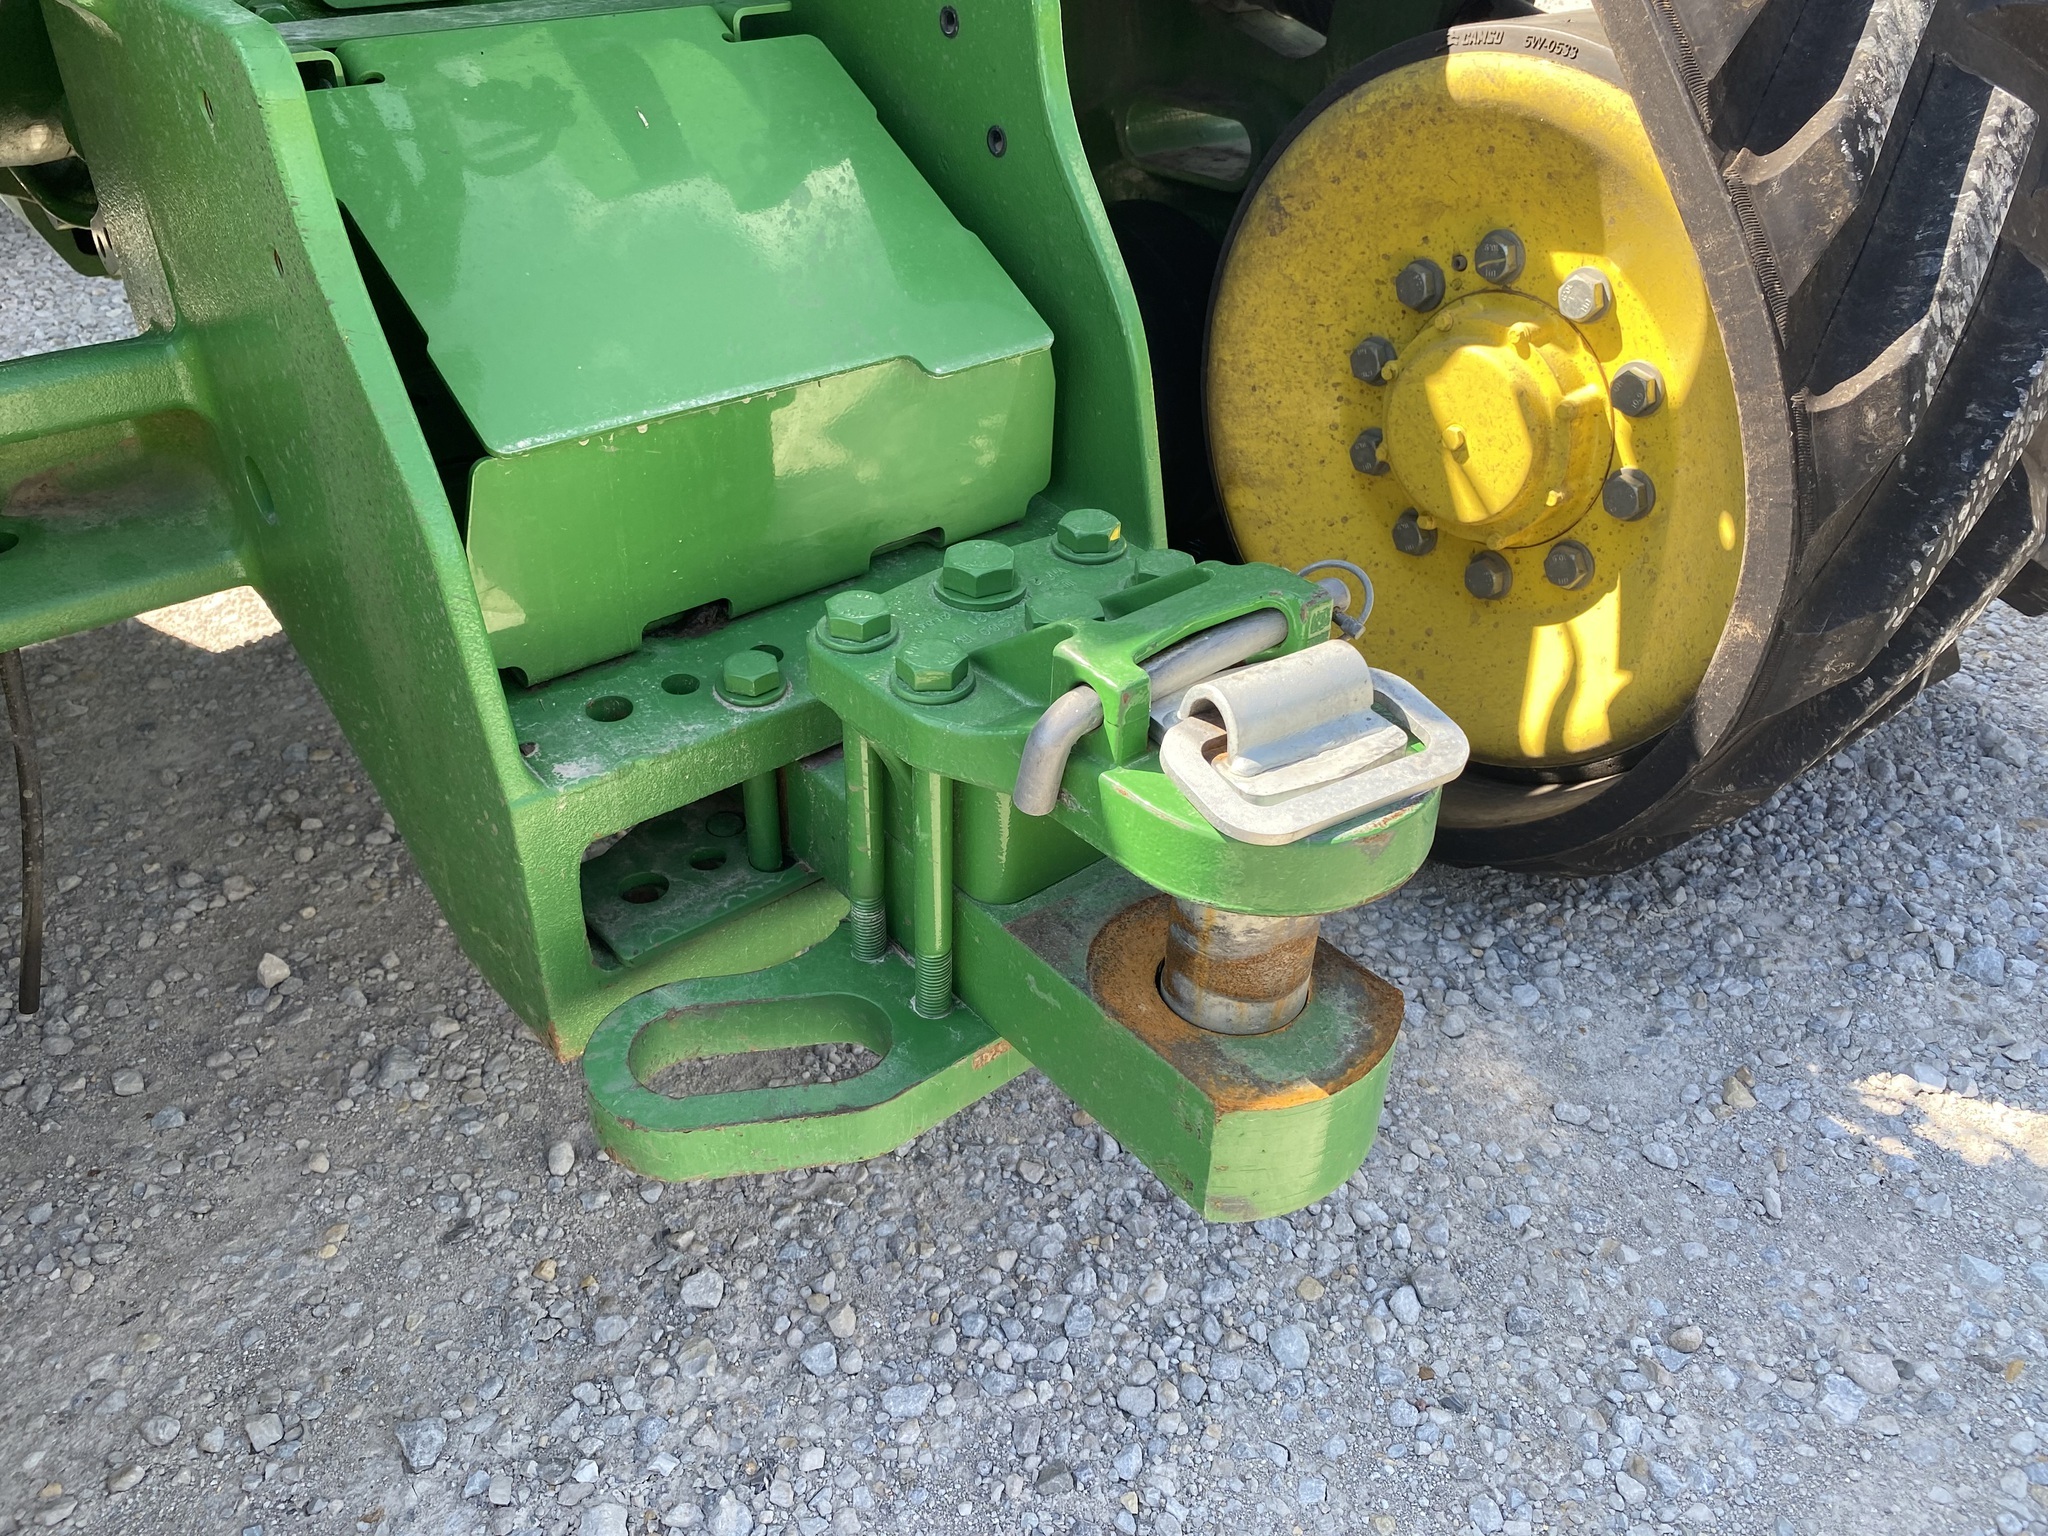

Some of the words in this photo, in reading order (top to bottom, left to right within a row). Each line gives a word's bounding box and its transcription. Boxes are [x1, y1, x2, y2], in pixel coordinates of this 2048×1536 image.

[1462, 30, 1505, 46] CAMSO
[1524, 35, 1580, 60] 5W-0533
[1631, 392, 1644, 409] 10.9
